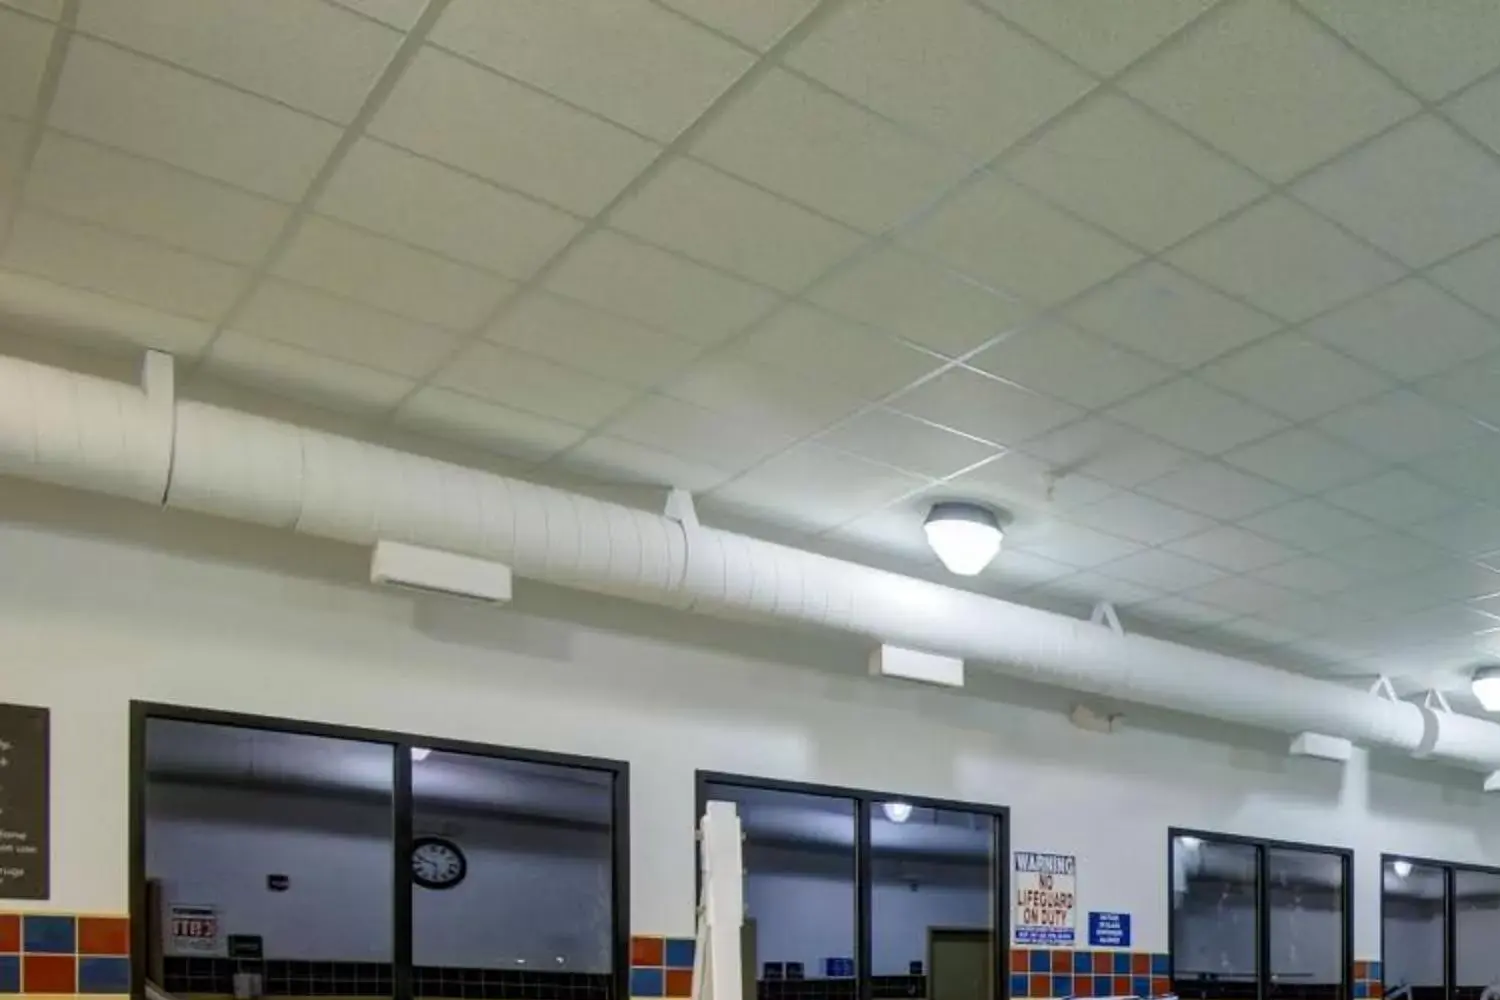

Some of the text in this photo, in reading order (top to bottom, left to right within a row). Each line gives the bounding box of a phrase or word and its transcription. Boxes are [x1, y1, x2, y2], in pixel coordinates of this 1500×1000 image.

[1017, 854, 1073, 875] WARNING
[1039, 875, 1053, 890] NO
[1018, 889, 1073, 909] LIFEGUARD
[1023, 908, 1067, 926] ON DUTY
